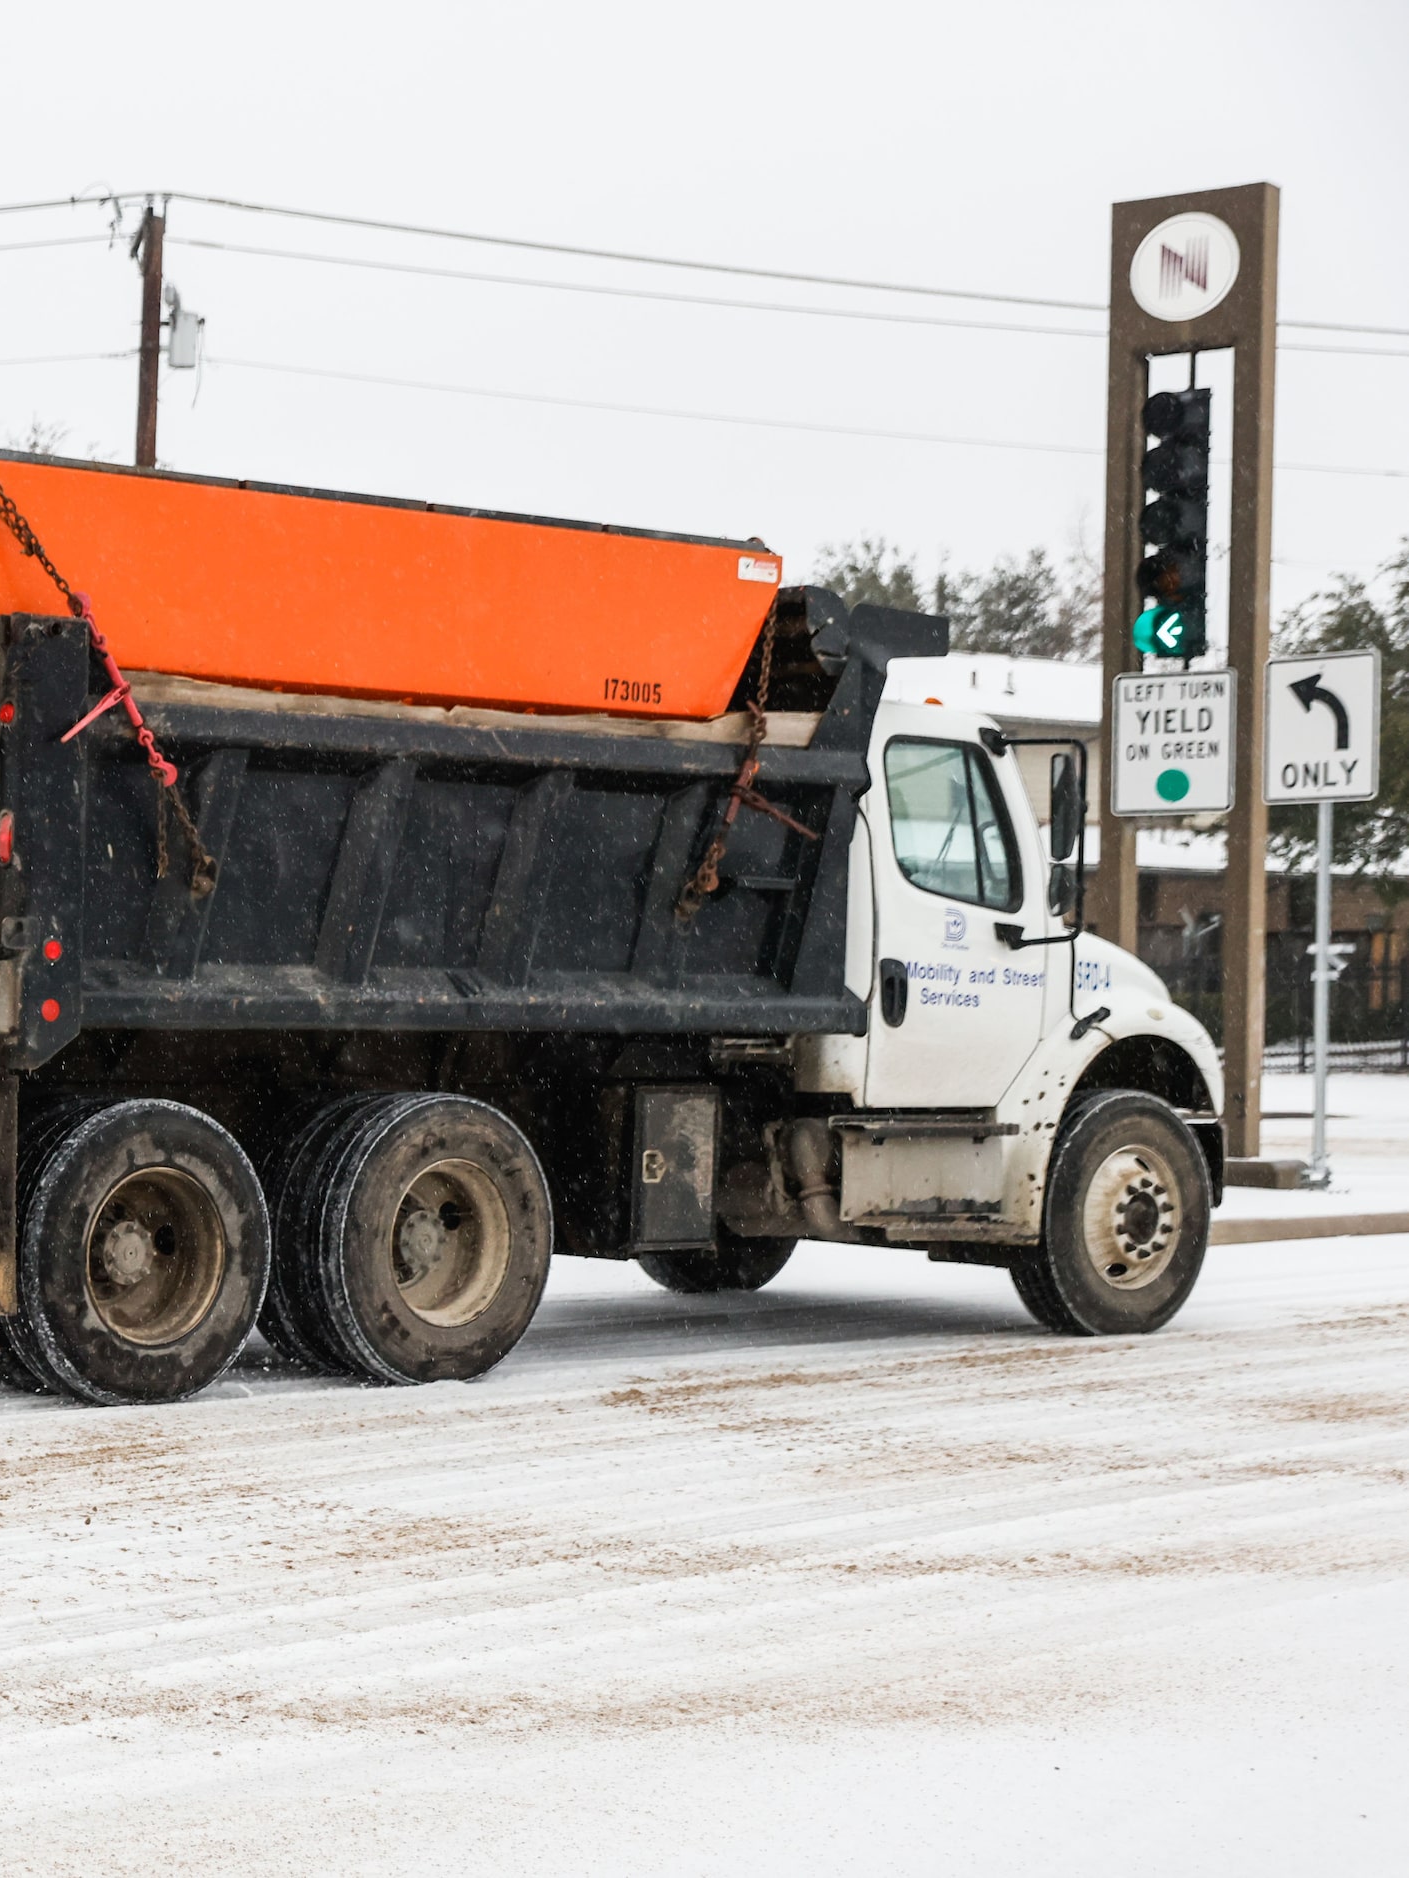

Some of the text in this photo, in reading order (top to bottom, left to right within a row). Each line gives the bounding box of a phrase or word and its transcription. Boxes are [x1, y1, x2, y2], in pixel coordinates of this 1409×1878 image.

[604, 678, 662, 705] 173005
[1124, 681, 1225, 702] LEFT TURN
[1135, 707, 1213, 735] YIELD
[1126, 741, 1219, 761] ON GREEN
[1281, 759, 1358, 789] ONLY
[906, 961, 1046, 988] Mobility and Street
[920, 987, 980, 1008] Services
